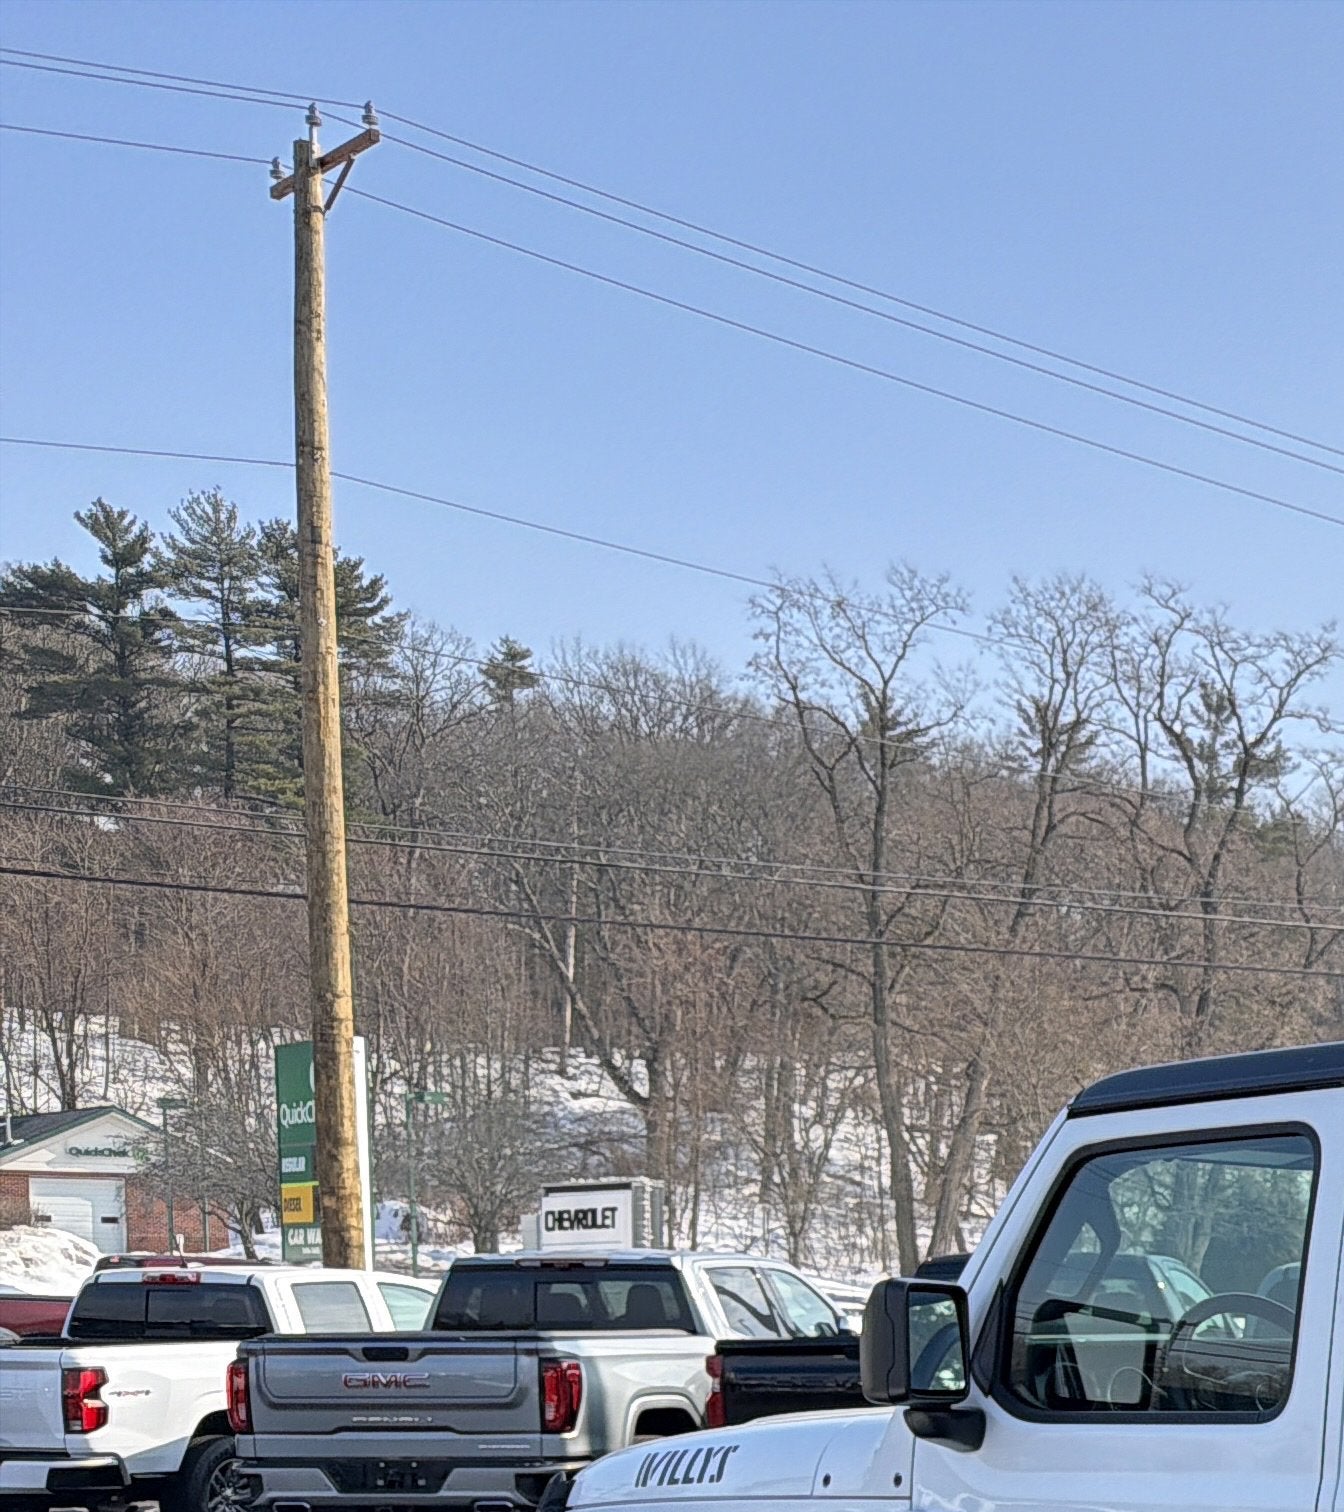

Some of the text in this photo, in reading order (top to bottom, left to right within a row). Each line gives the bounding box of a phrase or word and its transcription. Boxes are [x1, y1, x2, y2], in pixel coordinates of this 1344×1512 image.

[544, 1206, 618, 1232] CHEVROLET
[342, 1372, 431, 1389] GMC
[634, 1444, 741, 1488] WILLYS
